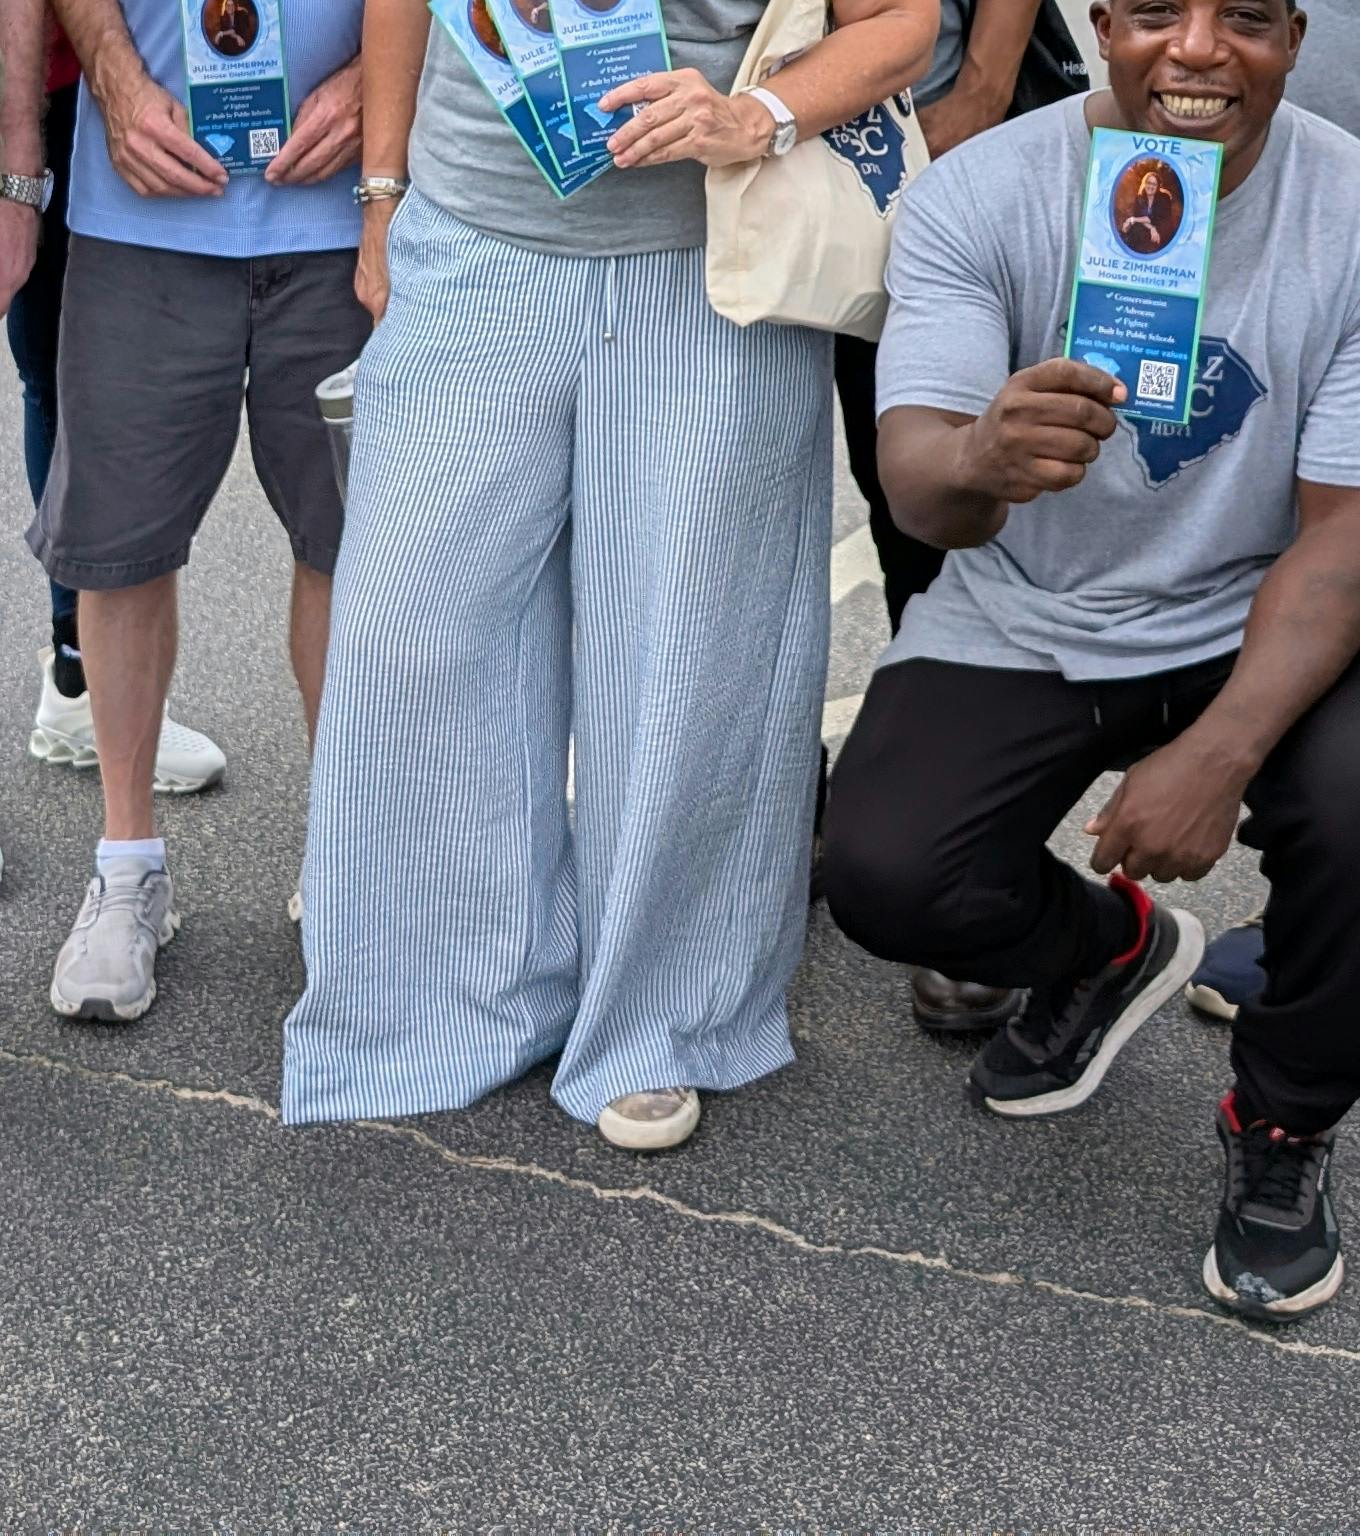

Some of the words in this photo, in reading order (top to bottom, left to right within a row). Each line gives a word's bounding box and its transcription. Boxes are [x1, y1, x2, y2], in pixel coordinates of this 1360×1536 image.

[562, 22, 589, 35] JULIE
[592, 11, 653, 30] ZIMMERMAN
[574, 32, 599, 41] House
[602, 27, 631, 37] District
[520, 46, 545, 63] JULIE
[192, 64, 218, 73] JULIE
[221, 59, 278, 70] ZIMMERMAN
[1062, 60, 1087, 75] Hea
[1131, 135, 1182, 155] VOTE
[1085, 255, 1120, 269] JULIE
[1123, 260, 1196, 279] ZIMMERMAN
[1098, 270, 1128, 281] House
[1130, 274, 1165, 287] District
[1167, 279, 1178, 288] 71
[1109, 342, 1130, 353] fight
[1131, 344, 1144, 353] for
[1202, 355, 1224, 381] Z
[1190, 382, 1215, 417] C
